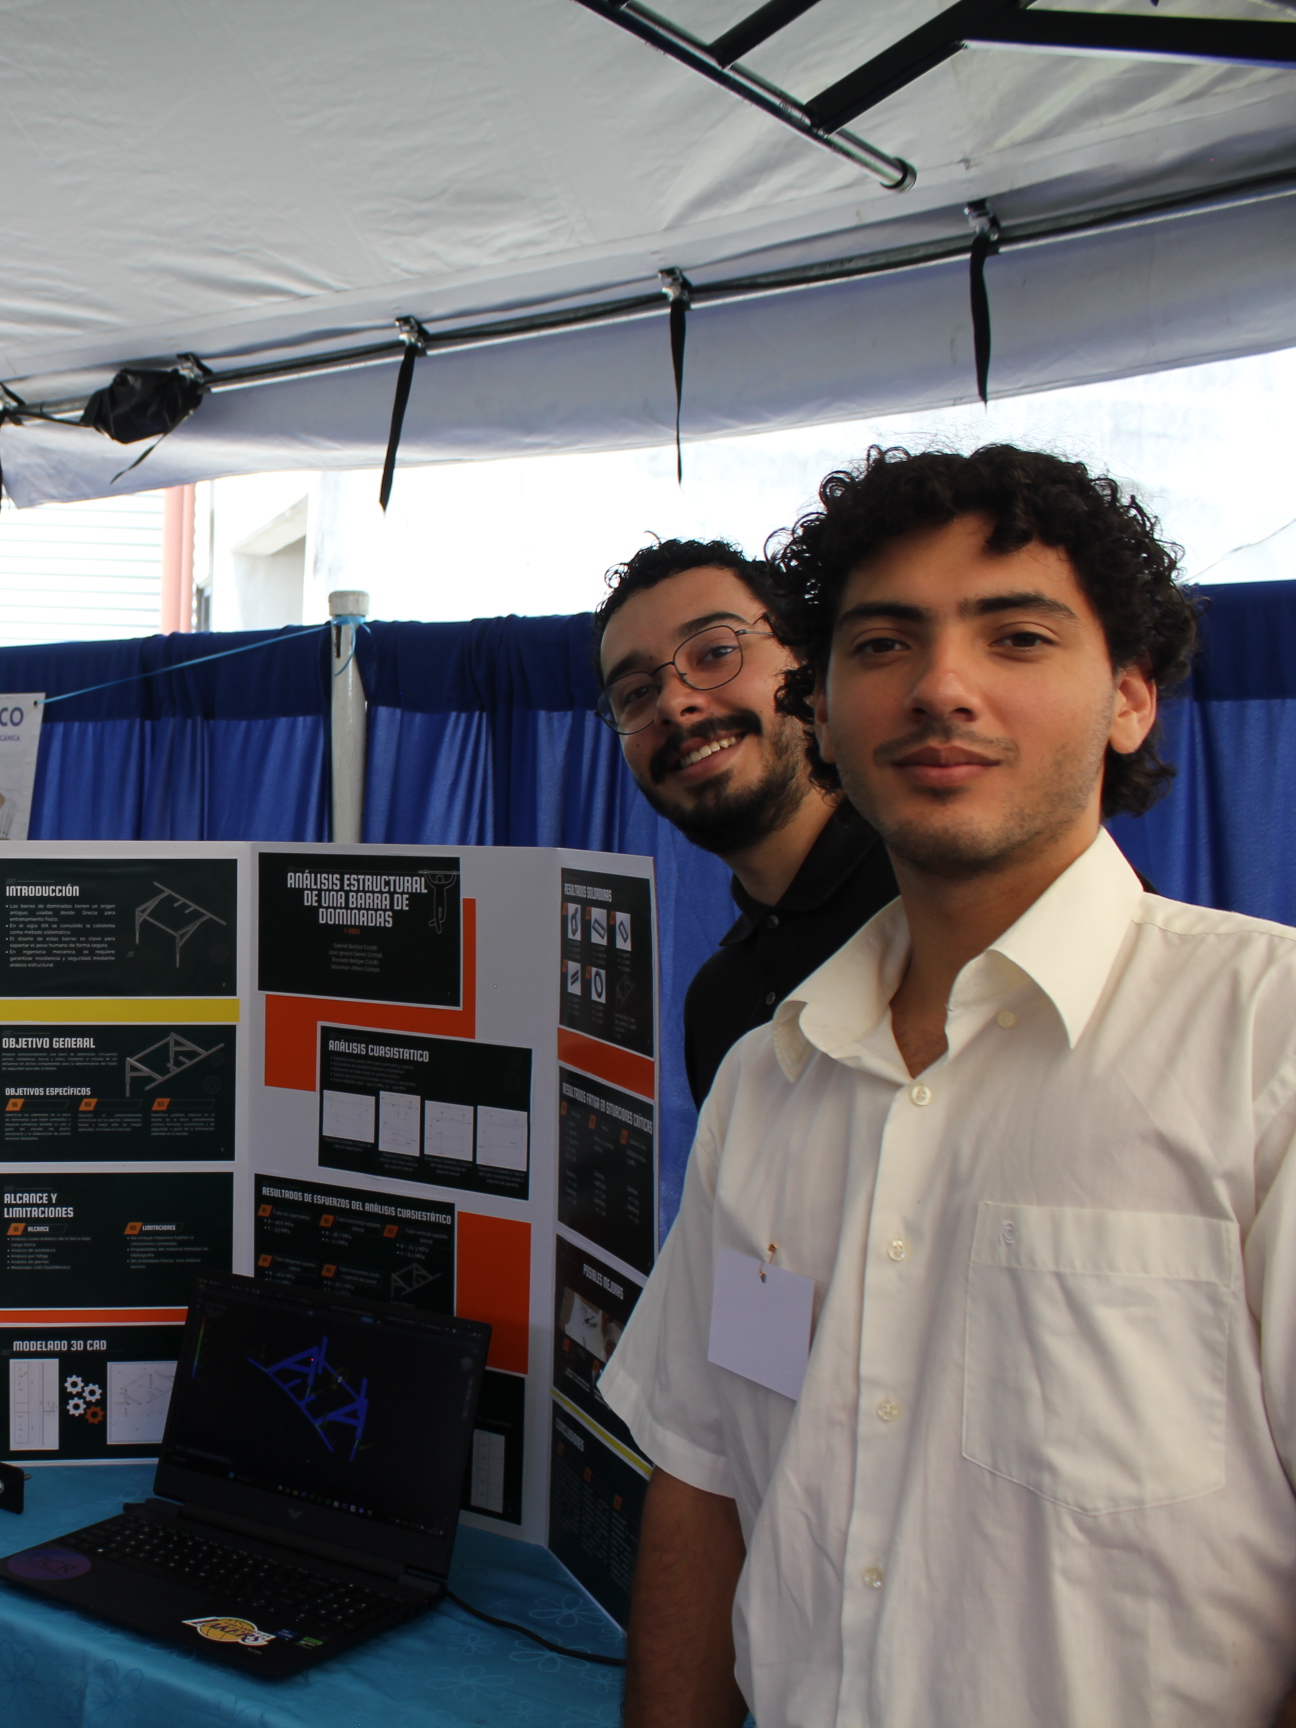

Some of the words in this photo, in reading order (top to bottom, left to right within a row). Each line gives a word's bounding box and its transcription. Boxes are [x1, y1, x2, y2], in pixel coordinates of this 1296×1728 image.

[6, 884, 79, 896] INTRODUCCIÓN
[287, 870, 341, 890] ANÁLISIS
[344, 874, 428, 893] ESTRUCTURAL
[304, 890, 318, 906] DE
[322, 892, 344, 907] UNA
[349, 893, 390, 910] BARRA
[394, 894, 409, 910] DE
[319, 908, 392, 928] DOMINADAS
[2, 1037, 50, 1049] OBJETIVO
[53, 1037, 95, 1049] GENERAL
[329, 1040, 366, 1055] ANÁLISIS
[368, 1044, 429, 1062] CUASISTATICO
[5, 1087, 44, 1096] OBJETIVOS
[46, 1086, 91, 1096] ESPECÍFICOS
[562, 1082, 586, 1103] RESULTADOS
[586, 1092, 600, 1110] FATIGA
[606, 1101, 633, 1124] SITUACIONES
[4, 1194, 48, 1204] ALCANCE
[51, 1193, 57, 1204] Y
[262, 1186, 303, 1201] RESULTADOS
[304, 1194, 313, 1203] DE
[314, 1195, 350, 1209] ESFUERZOS
[352, 1200, 363, 1210] DEL
[365, 1202, 396, 1216] ANÁLISIS
[397, 1207, 452, 1225] CUASIESTÁTICO
[4, 1207, 74, 1218] LIMITACIONES
[582, 1264, 602, 1287] POSIBLES
[603, 1275, 624, 1300] MEJORAS
[13, 1341, 67, 1351] MODELADO
[71, 1340, 83, 1350] 3D
[87, 1340, 107, 1350] CAD
[556, 1417, 584, 1452] CONCLUSIONES
[26, 1553, 76, 1574] UCR
[193, 1618, 264, 1643] LAKERS
